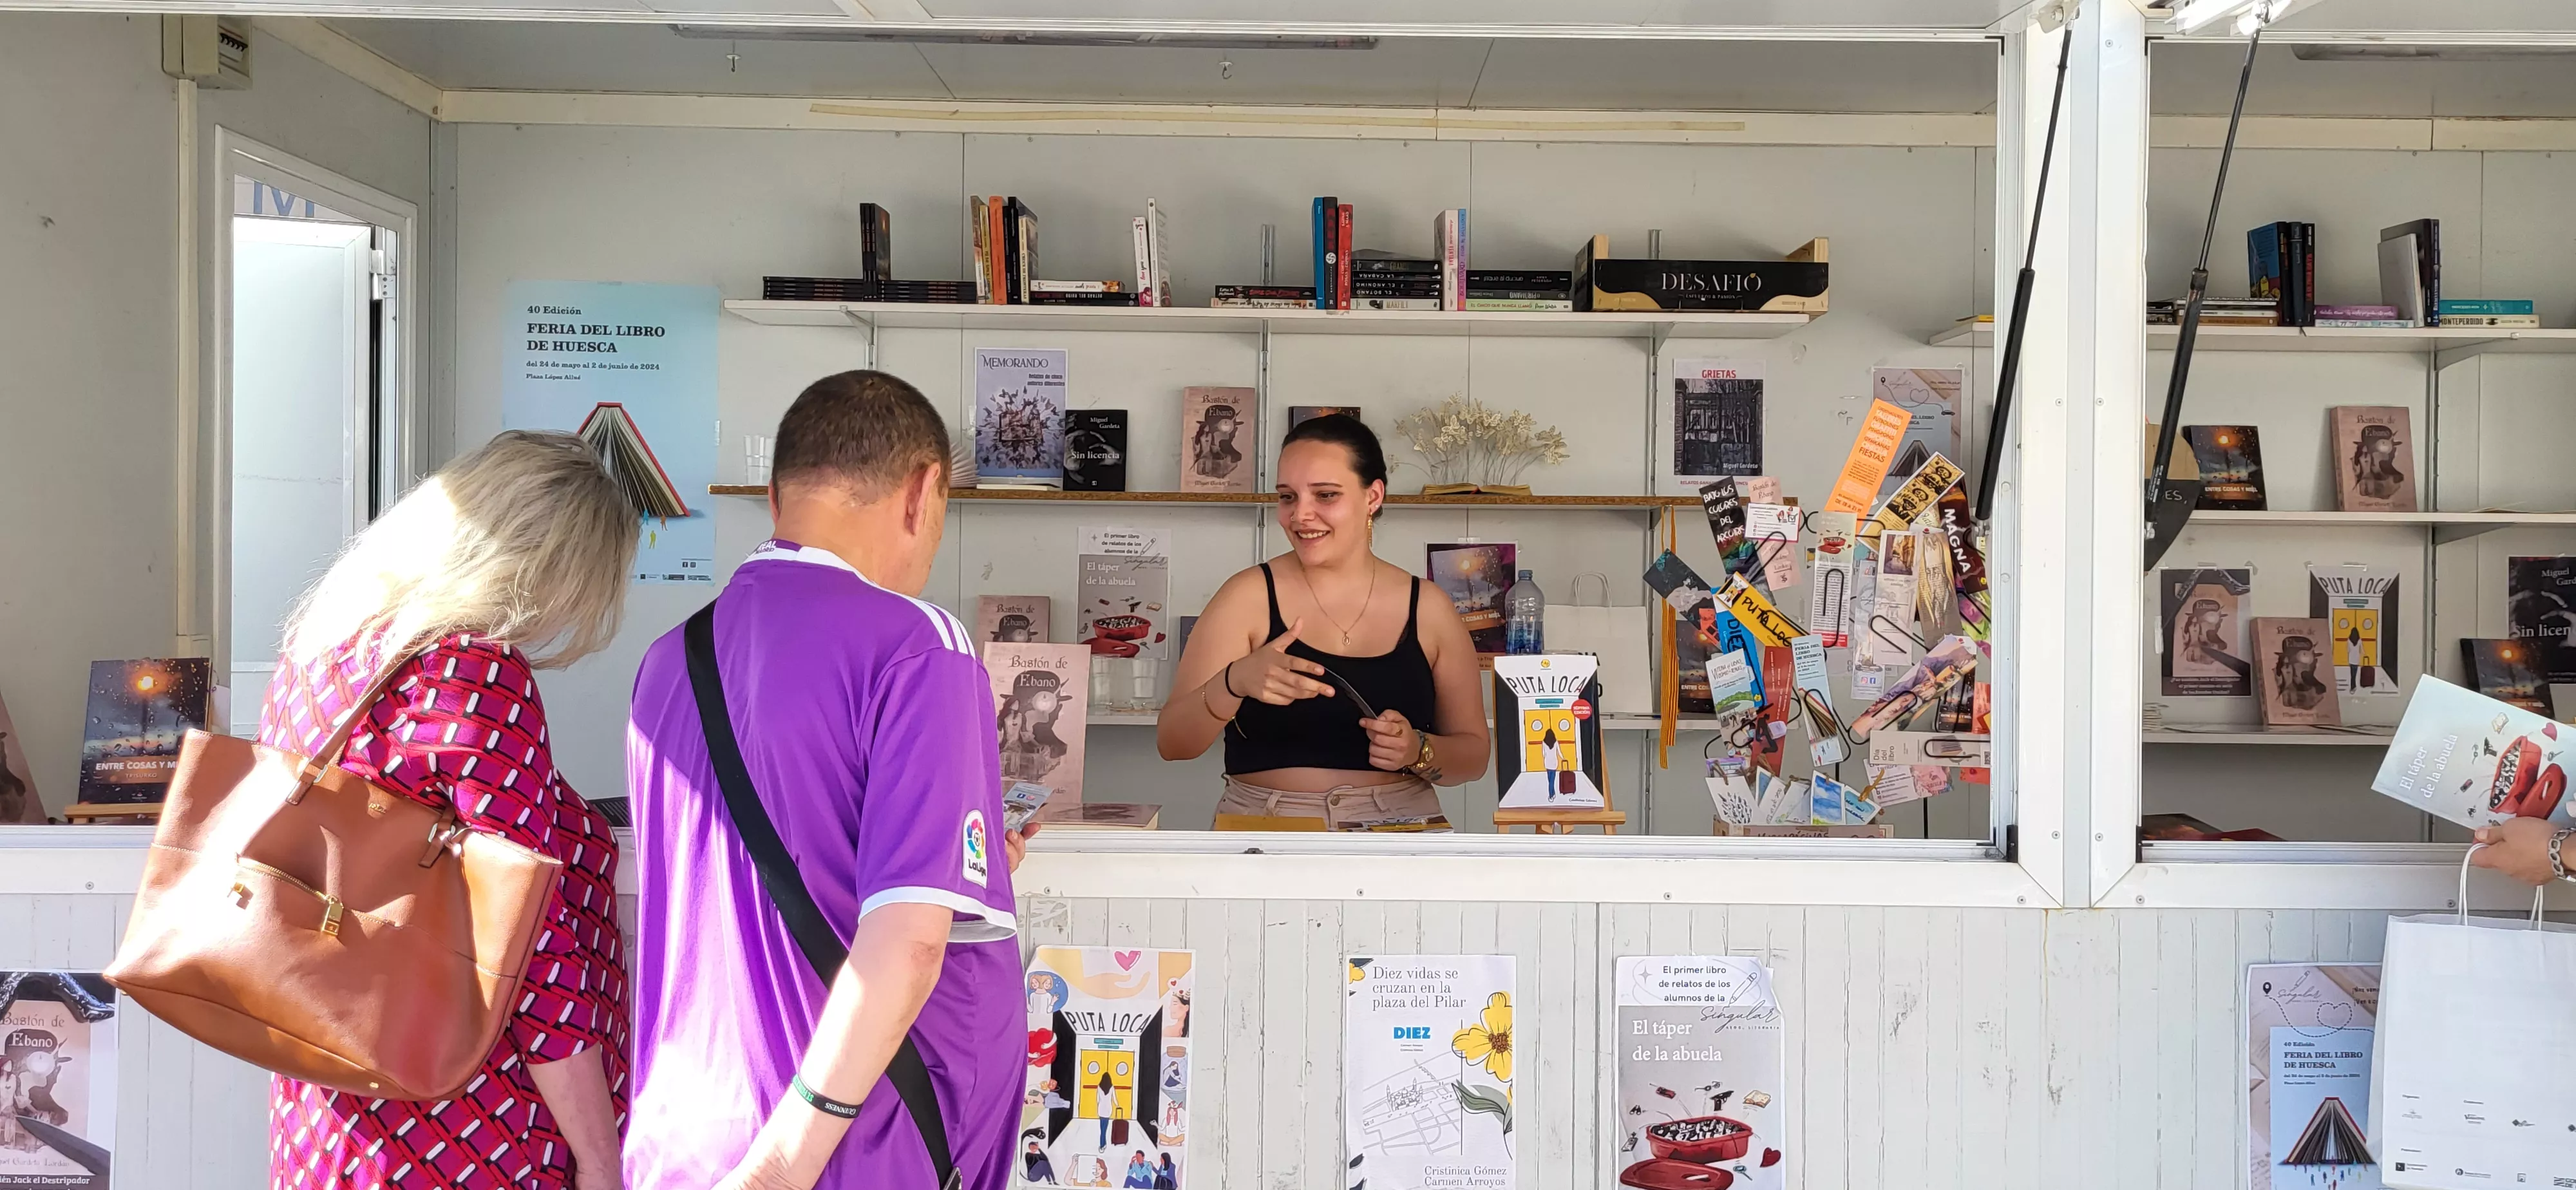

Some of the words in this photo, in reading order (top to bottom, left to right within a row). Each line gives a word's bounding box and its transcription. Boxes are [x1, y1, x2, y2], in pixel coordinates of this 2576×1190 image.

[543, 306, 582, 315] Edición
[527, 323, 576, 335] FERIA
[581, 325, 612, 335] DEL
[616, 326, 665, 337] LIBRO
[527, 341, 548, 351] DE
[553, 341, 617, 353] HUESCA
[981, 354, 1048, 370] MEMORANDO
[1702, 370, 1736, 379] GRIETAS
[1201, 394, 1228, 404] Bastón
[2357, 415, 2383, 424] Bastón
[2387, 415, 2396, 424] de
[1072, 451, 1085, 460] Sin
[1087, 451, 1120, 460] licencia
[1859, 447, 1886, 463] FIESTAS
[1703, 490, 1720, 503] BAJO
[1708, 498, 1738, 514] COLORES
[1719, 516, 1733, 526] DEL
[1944, 509, 1971, 572] MAGNA
[1098, 563, 1119, 573] táper
[1124, 552, 1168, 571] Singular
[2541, 567, 2570, 578] Miguel
[1086, 575, 1096, 585] de
[1099, 576, 1106, 585] la
[1108, 576, 1135, 585] abuela
[2318, 577, 2353, 594] PUTA
[2358, 578, 2392, 594] LOCA
[2556, 578, 2576, 586] Gard
[996, 603, 1025, 614] Bastón
[1741, 596, 1770, 627] PUTA
[1771, 623, 1792, 647] LOC
[2512, 625, 2534, 637] Sin
[2539, 624, 2570, 636] licen
[1009, 654, 1050, 669] Bastón
[1056, 656, 1067, 669] de
[1017, 669, 1056, 687] Ébano
[1506, 676, 1545, 694] PUTA
[1552, 676, 1587, 693] LOCA
[2434, 735, 2458, 770] abuela
[96, 761, 124, 771] ENTRE
[127, 761, 156, 770] COSAS
[158, 760, 166, 769] Y
[2400, 777, 2414, 790] El
[2408, 747, 2427, 775] táper
[2427, 773, 2441, 783] la
[2421, 784, 2435, 798] de
[1372, 966, 1402, 980] Diez
[1406, 966, 1441, 980] vidas
[1445, 968, 1459, 979] se
[1674, 967, 1704, 976] primer
[1706, 965, 1727, 974] libro
[1372, 983, 1416, 994] cruzan
[1420, 984, 1435, 994] en
[1440, 980, 1452, 994] la
[2278, 986, 2323, 1005] Singular
[1372, 996, 1405, 1012] plaza
[1410, 995, 1429, 1008] del
[1434, 996, 1466, 1008] Pilar
[2, 1012, 44, 1028] Bastón
[51, 1015, 64, 1028] de
[1065, 1010, 1106, 1032] PUTA
[1112, 1013, 1152, 1033] LOCA
[1700, 999, 1780, 1034] Singular
[1393, 1027, 1431, 1039] DIEZ
[1632, 1019, 1649, 1035] El
[1652, 1020, 1692, 1040] táper
[8, 1028, 53, 1048] Ébano
[1632, 1046, 1651, 1061] de
[1655, 1046, 1669, 1061] la
[1672, 1046, 1723, 1062] abuela
[825, 1102, 856, 1115] GUINNESS
[1424, 1165, 1471, 1176] Cristinica
[1473, 1165, 1507, 1176] Gómez
[41, 1176, 90, 1185] Destripador
[1424, 1176, 1463, 1187] Carmen
[1466, 1177, 1506, 1188] Arroyos
